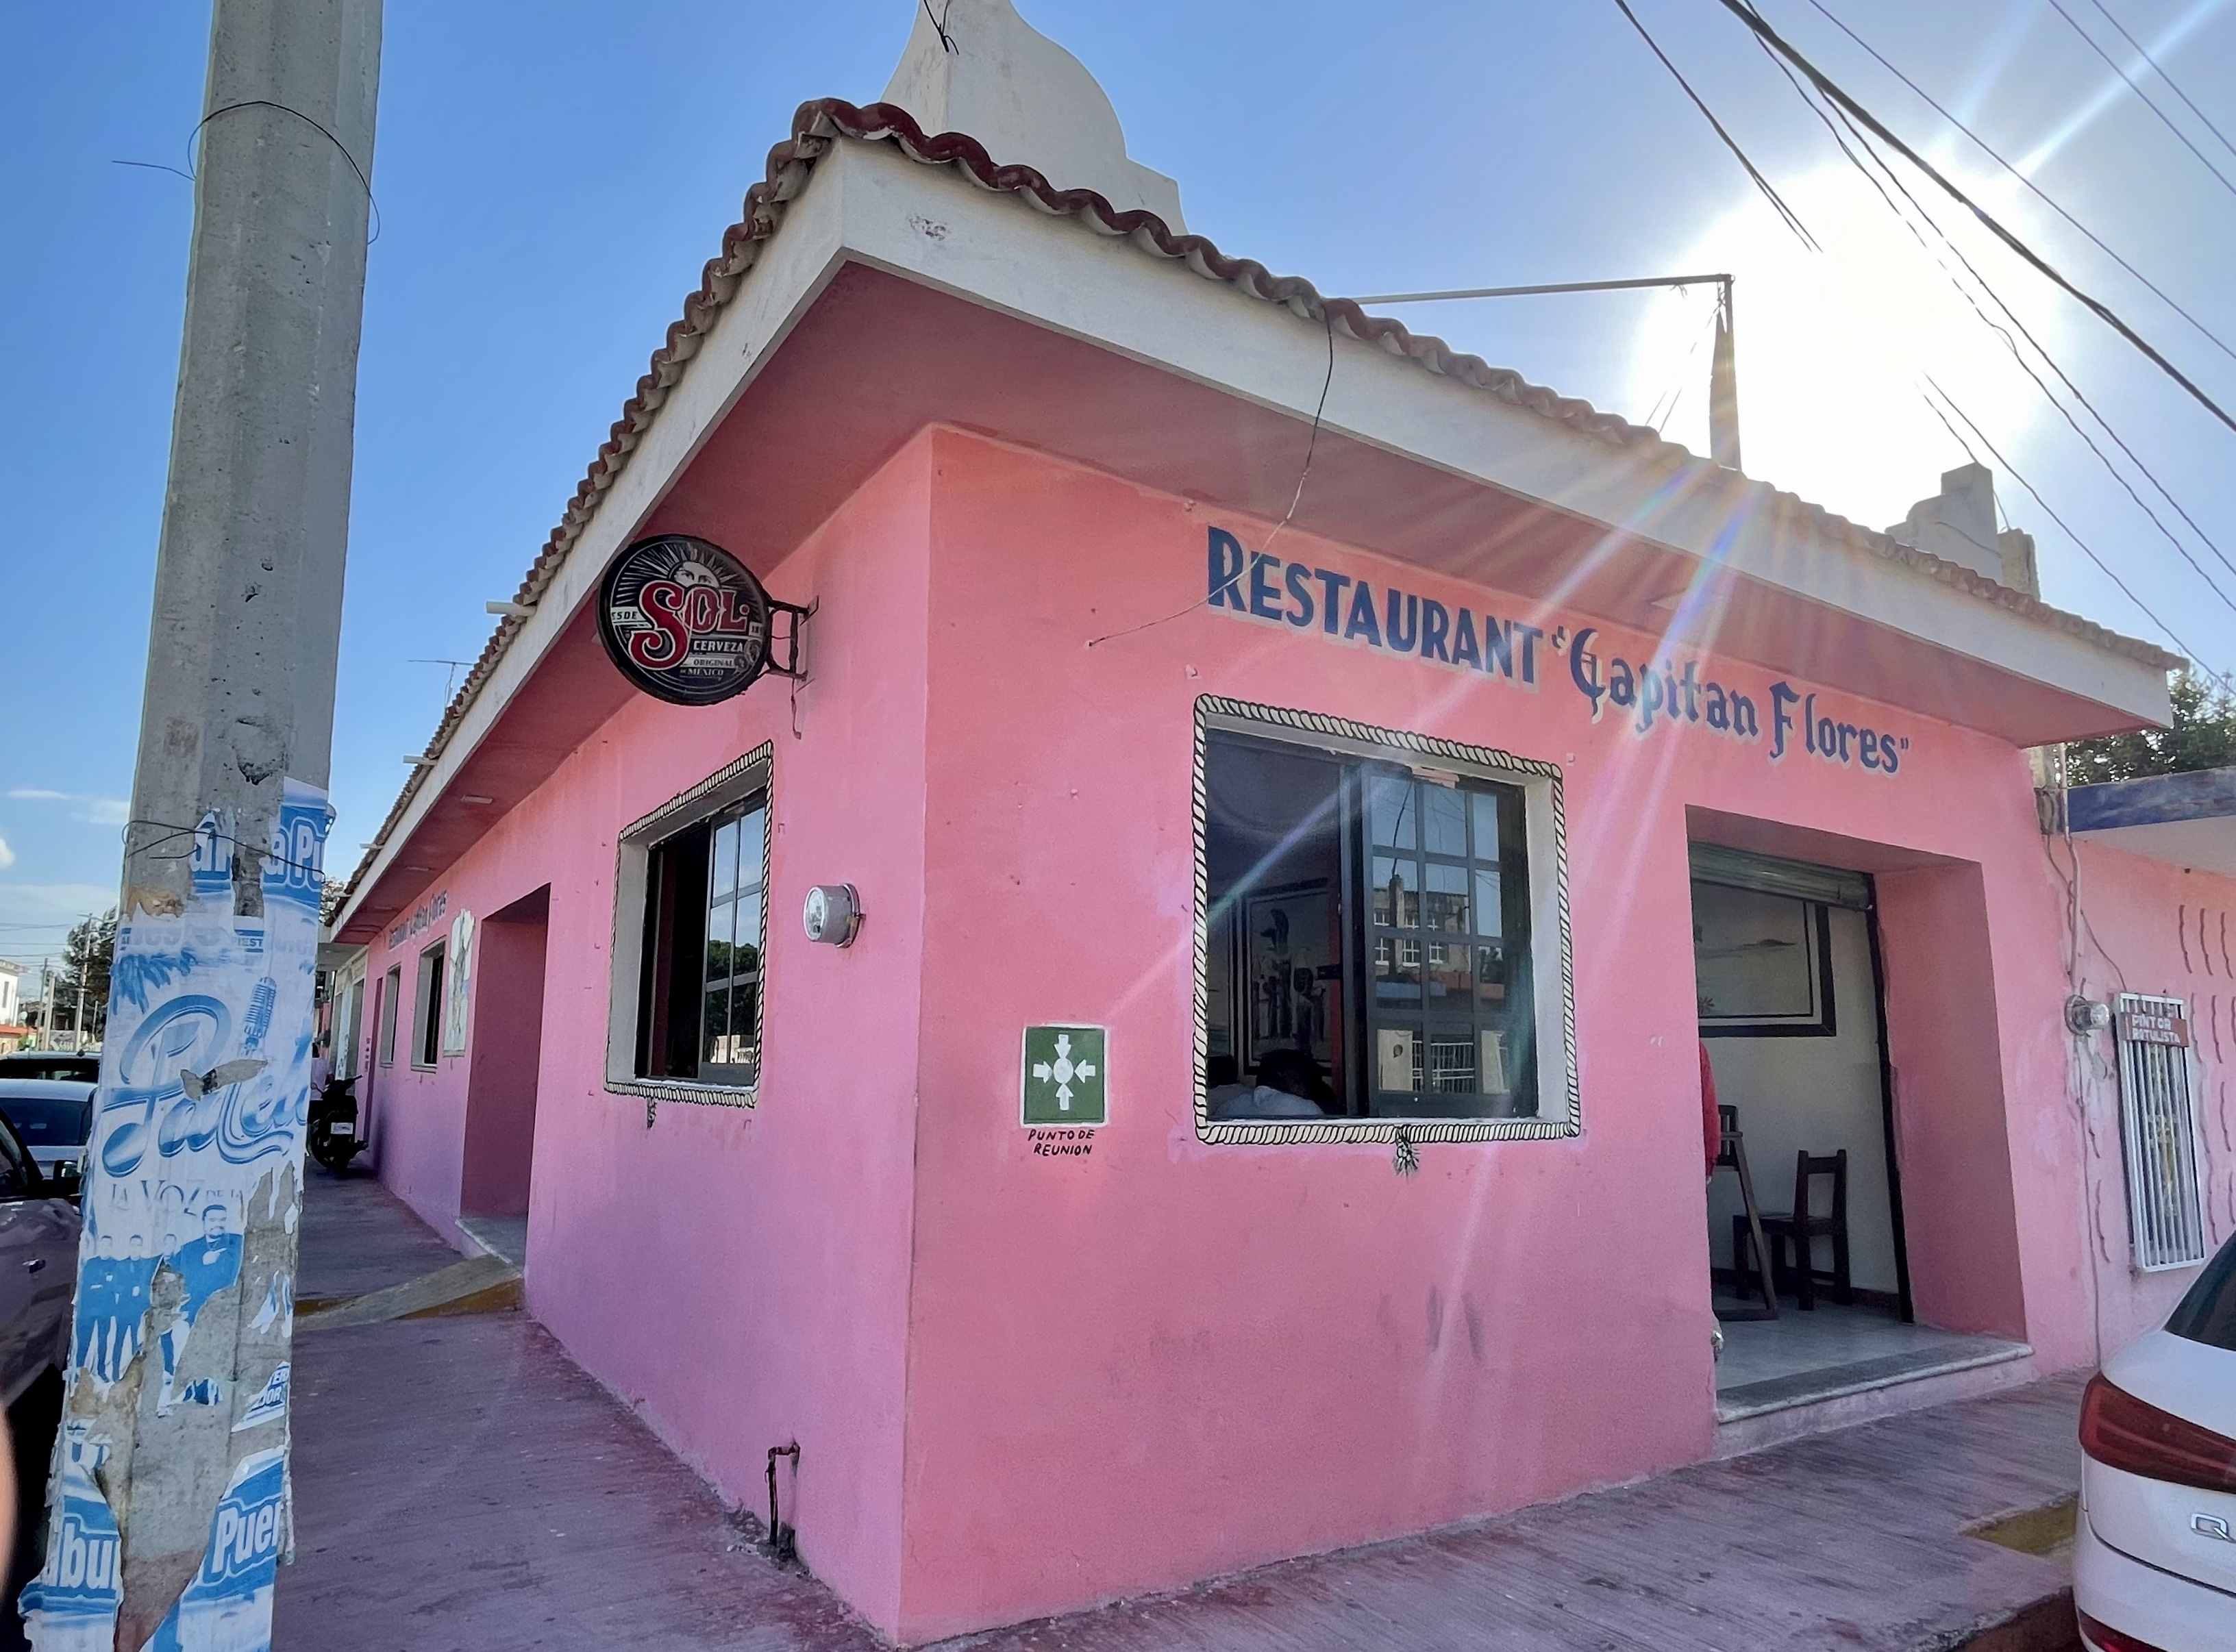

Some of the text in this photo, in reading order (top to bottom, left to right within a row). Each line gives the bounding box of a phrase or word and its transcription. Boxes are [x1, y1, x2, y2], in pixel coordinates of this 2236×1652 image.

[1207, 525, 1544, 687] RESTAURANT
[693, 640, 743, 652] CERVEZA
[1028, 1129, 1095, 1141] PUNTO DE
[1033, 1142, 1093, 1157] REUNION
[139, 1179, 205, 1217] VOZ
